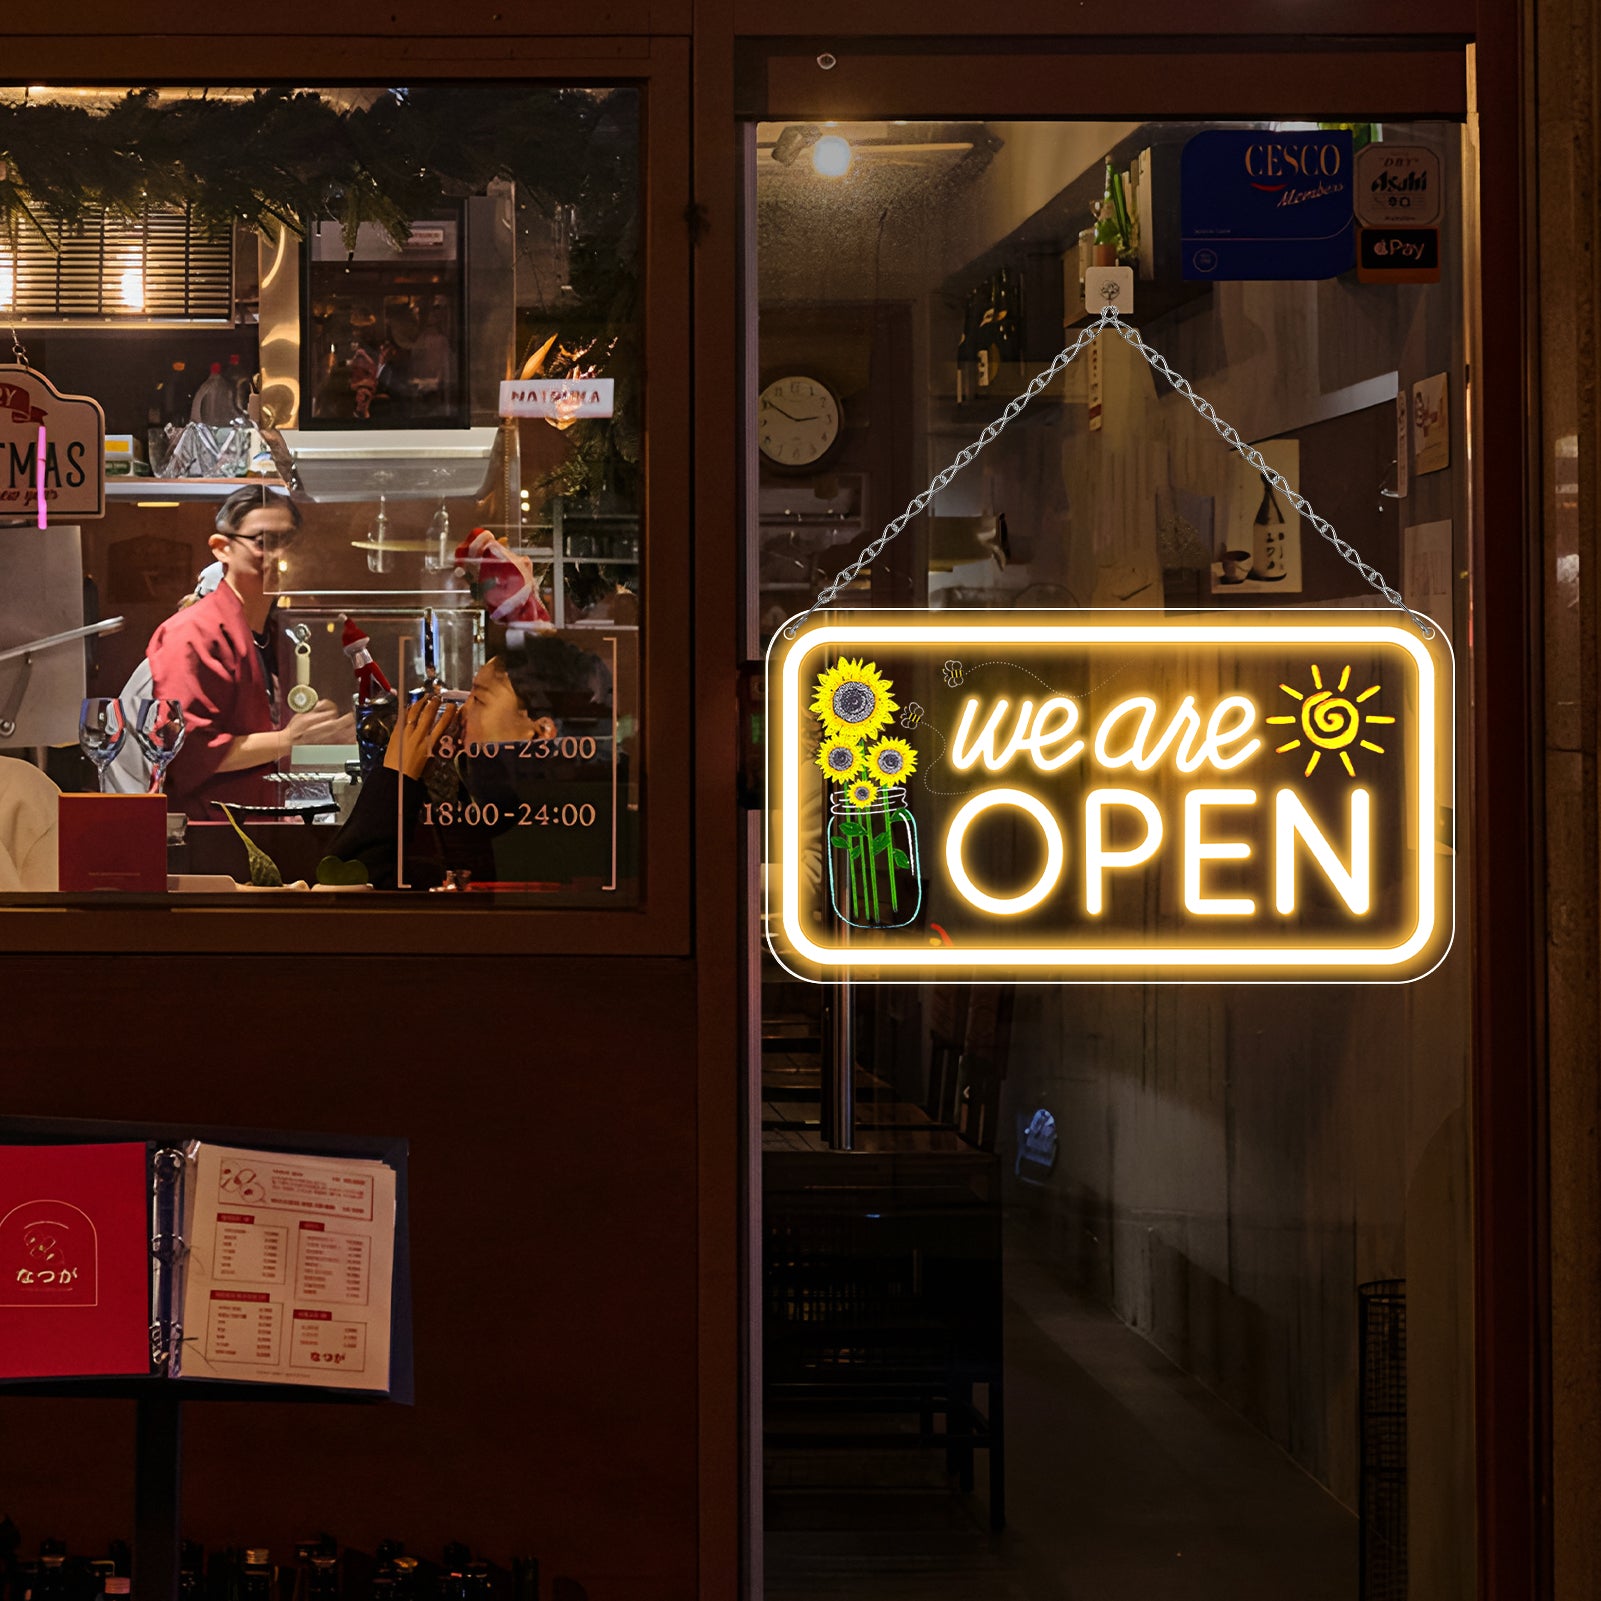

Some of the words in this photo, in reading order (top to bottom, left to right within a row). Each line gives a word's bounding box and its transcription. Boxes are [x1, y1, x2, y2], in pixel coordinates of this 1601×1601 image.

[1244, 143, 1341, 177] CESCO
[1371, 170, 1427, 192] Asahi
[1390, 239, 1425, 261] Pay
[0, 441, 86, 488] MAS
[951, 695, 1085, 771] we
[1094, 695, 1262, 773] are
[945, 788, 1370, 916] OPEN
[16, 1267, 78, 1284] なつが
